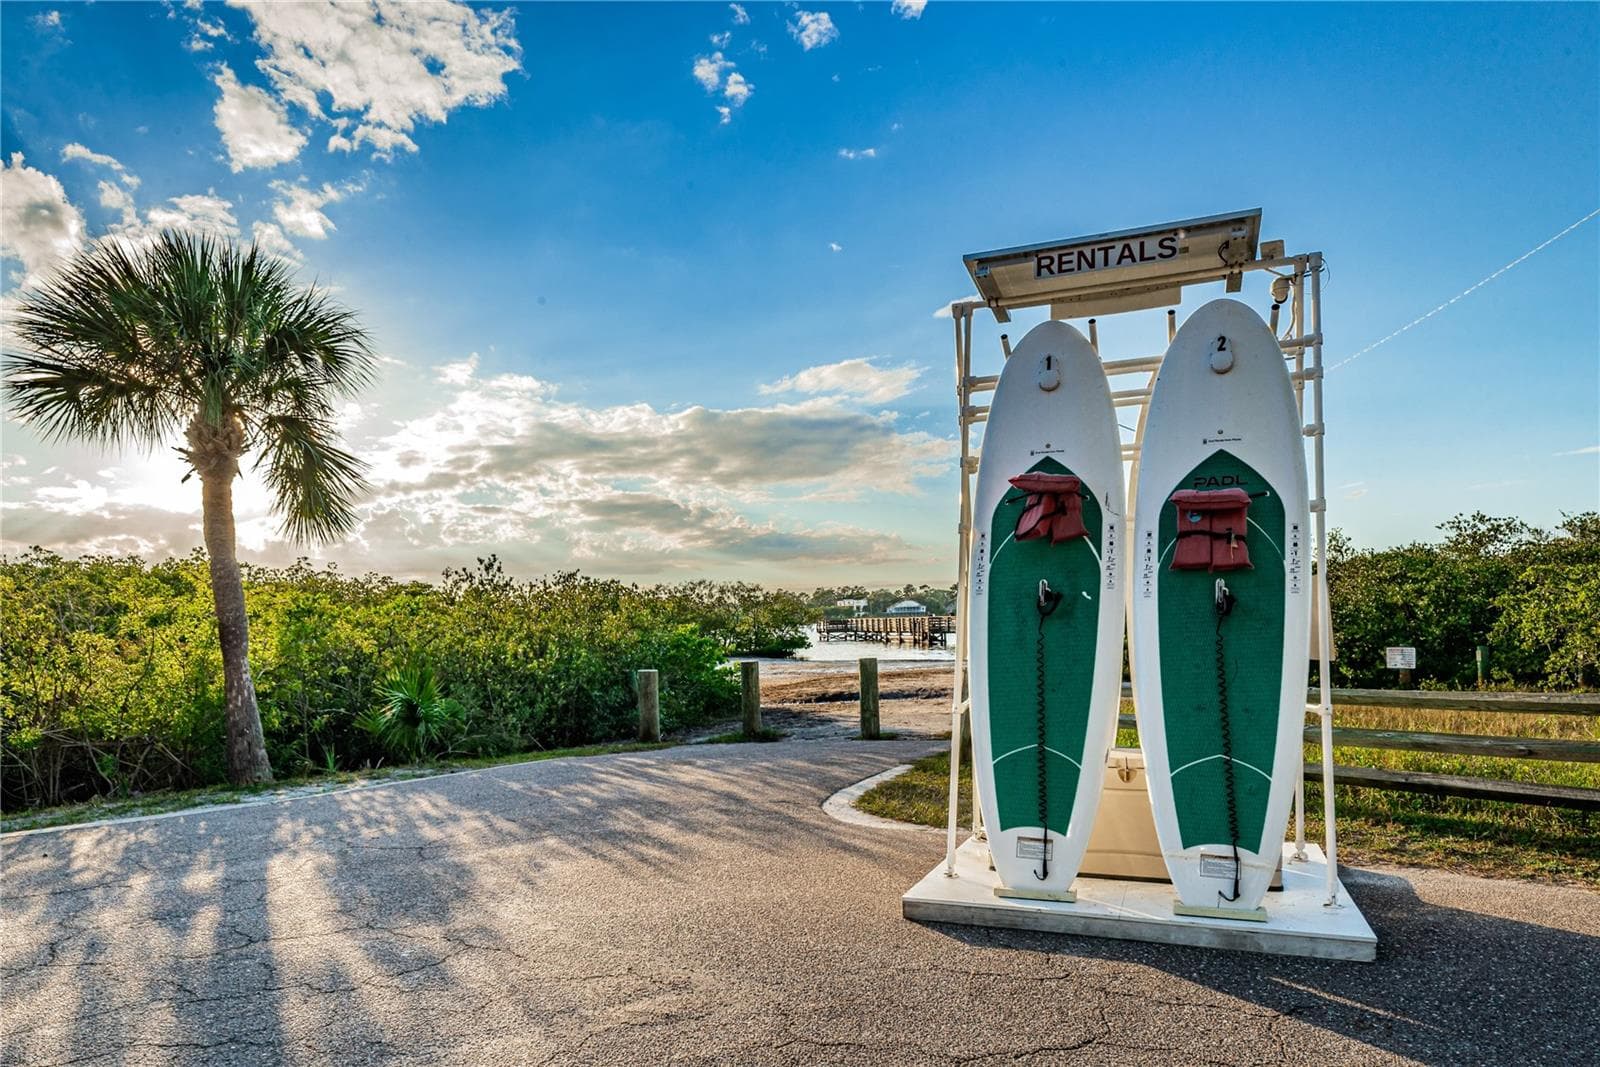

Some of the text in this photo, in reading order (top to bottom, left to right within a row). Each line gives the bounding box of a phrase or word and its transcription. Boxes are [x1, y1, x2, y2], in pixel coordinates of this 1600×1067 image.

[1036, 236, 1177, 277] RENTALS
[1217, 335, 1227, 352] 2
[1045, 355, 1052, 370] 1
[1194, 475, 1248, 488] PADL
